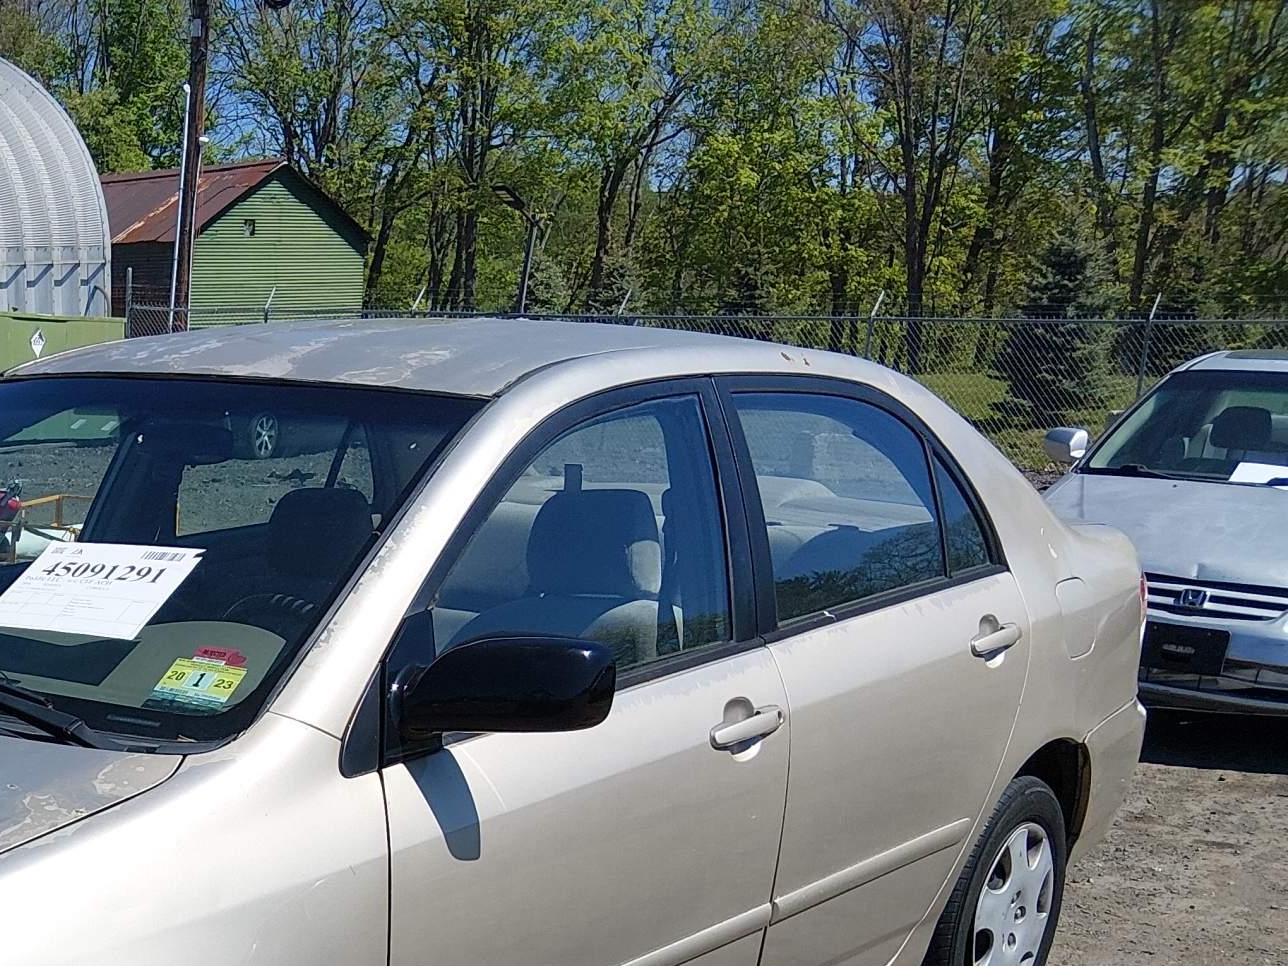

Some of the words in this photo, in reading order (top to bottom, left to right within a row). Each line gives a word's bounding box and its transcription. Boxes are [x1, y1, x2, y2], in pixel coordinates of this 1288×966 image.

[42, 561, 167, 583] 45091291
[167, 670, 186, 681] 20
[192, 672, 206, 688] 1
[213, 678, 234, 690] 23
